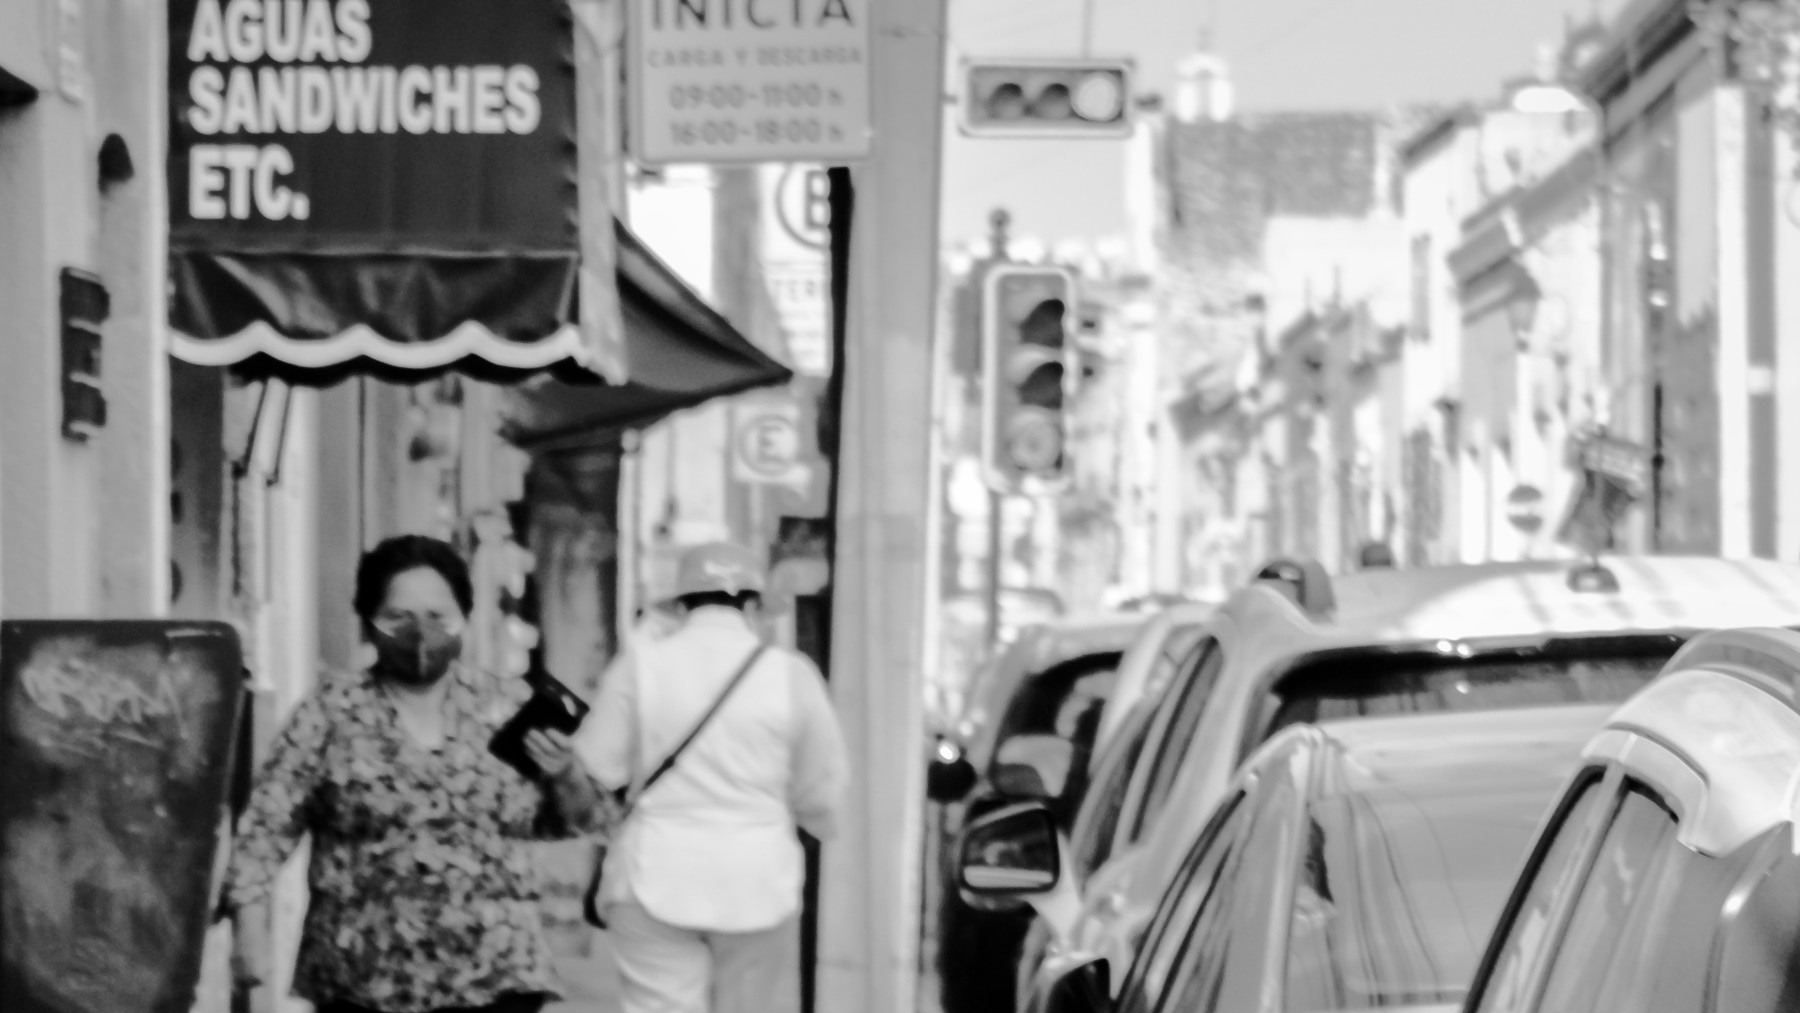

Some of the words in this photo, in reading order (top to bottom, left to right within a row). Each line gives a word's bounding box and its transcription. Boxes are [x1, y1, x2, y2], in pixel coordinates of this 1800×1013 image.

[187, 0, 372, 63] AGUAS
[652, 0, 856, 31] INICIA
[647, 48, 724, 68] CARGA
[734, 48, 748, 67] Y
[756, 47, 862, 66] DESCARGA
[188, 64, 542, 135] SANDWICHES
[189, 143, 310, 221] ETC.
